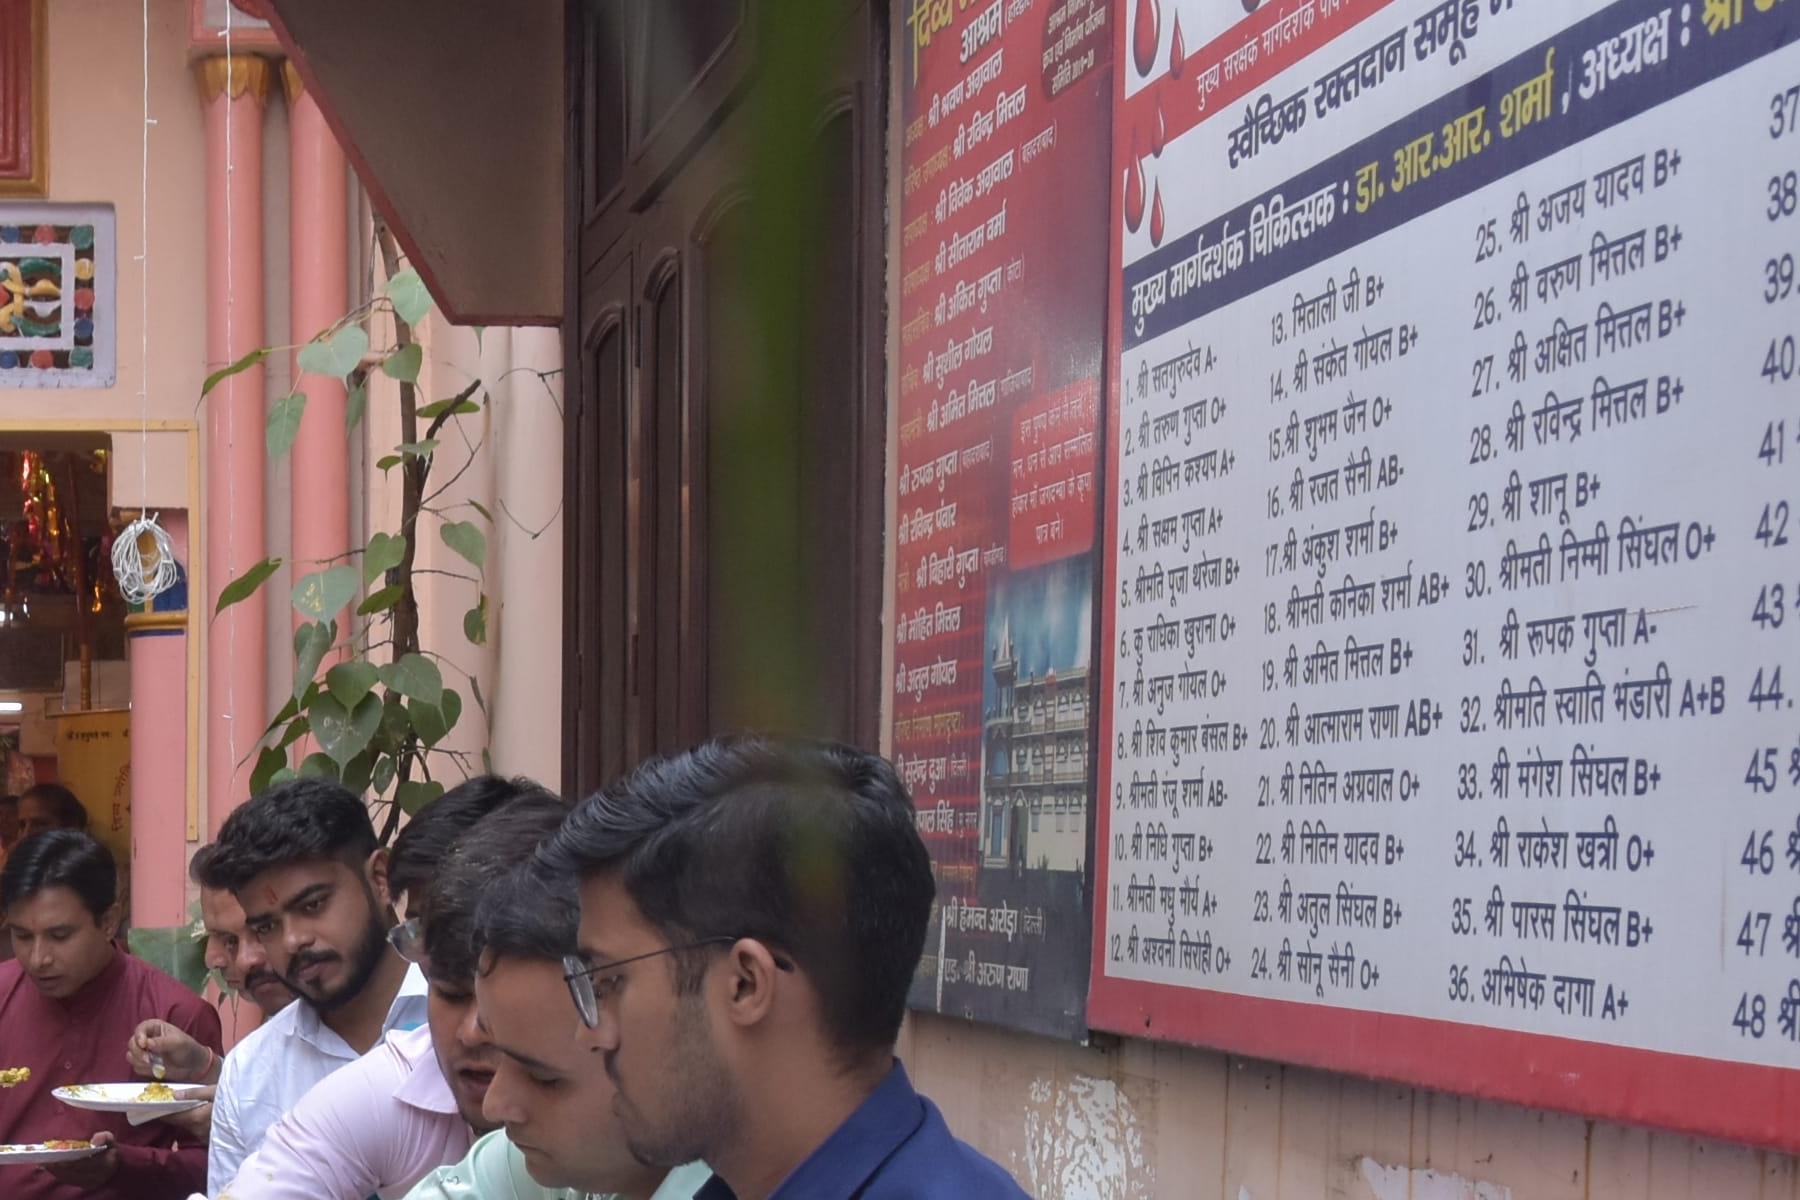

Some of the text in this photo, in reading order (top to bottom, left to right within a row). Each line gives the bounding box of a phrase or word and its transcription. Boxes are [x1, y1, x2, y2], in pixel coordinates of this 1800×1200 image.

[1196, 63, 1220, 111] मुख्य
[1314, 26, 1408, 119] रक्तदान
[1132, 269, 1167, 337] मुख्य
[1170, 221, 1246, 298] मार्गदर्शक
[1249, 187, 1337, 262] चिकित्सक
[1355, 161, 1384, 213] डा.
[1499, 47, 1555, 138] शर्मा
[1578, 8, 1672, 99] अध्यक्ष
[1767, 170, 1797, 222] 38
[1475, 148, 1681, 263] 25. श्री अजय यादव B+
[1473, 224, 1682, 330] 26. श्री वरुण मित्तल B+
[1270, 324, 1418, 404] 14. श्री संकेत गोयल B+
[1472, 299, 1686, 398] 27. श्री अक्षित मित्तल B+
[1469, 376, 1684, 464] 28. श्री रविन्द्र मित्तल B+
[1758, 420, 1784, 466] 41
[1267, 446, 1404, 519] 16. श्री रजत सैनी AB-
[1467, 470, 1600, 532] 29. श्री शानू B+
[1465, 516, 1716, 598] 30. श्रीमती निम्मी सिंघल O+
[1264, 560, 1449, 634] 18. श्रीमती कनिका शर्मा AB+
[1752, 583, 1784, 629] 43
[1146, 613, 1180, 652] राधिका
[1184, 613, 1217, 659] खुराना
[1463, 608, 1657, 668] 31. श्री रूपक गुप्ता A-
[1259, 698, 1443, 750] 20. श्री आत्माराम राणा AB+
[1460, 661, 1725, 733] 32. श्रीमति स्वाति भंडारी A+B
[1457, 743, 1661, 800] 33. श्री मंगेश सिंघल B+
[1171, 833, 1195, 874] गुप्ता
[1199, 835, 1213, 862] B+
[1256, 819, 1404, 865] 22. श्री नितिन यादव B+
[1455, 814, 1654, 872] 34. श्री राकेश खत्री O+
[1741, 830, 1774, 875] 46
[1452, 884, 1653, 947] 35. श्री पारस सिंघल B+
[1251, 937, 1379, 998] 24. श्री सोनू सैनी O+
[1448, 955, 1629, 1020] 36. अभिषेक दागा A+
[1732, 992, 1766, 1039] 48
